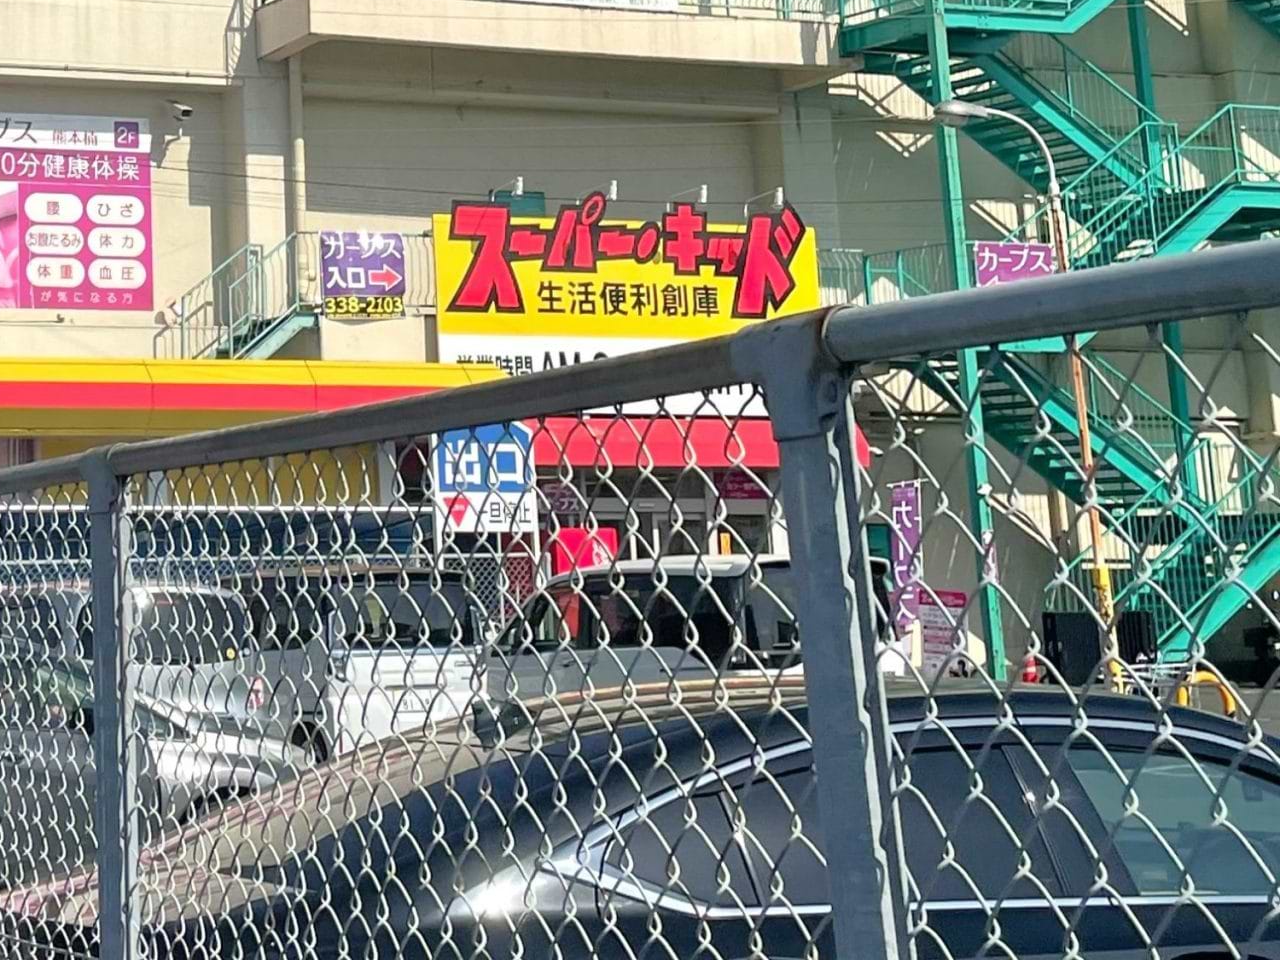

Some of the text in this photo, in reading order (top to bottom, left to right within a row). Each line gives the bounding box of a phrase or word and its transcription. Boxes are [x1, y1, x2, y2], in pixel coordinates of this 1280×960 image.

[116, 126, 137, 145] 2F
[97, 202, 134, 218] ひざ
[98, 233, 135, 249] 体力
[447, 191, 806, 319] スーパー・キッド
[976, 246, 1052, 273] カーブス
[37, 263, 74, 280] 体重
[98, 265, 136, 281] 血圧
[326, 266, 367, 289] 入口
[324, 296, 403, 314] 338-2103
[536, 280, 721, 317] 生活便利創庫
[444, 441, 526, 485] 出口
